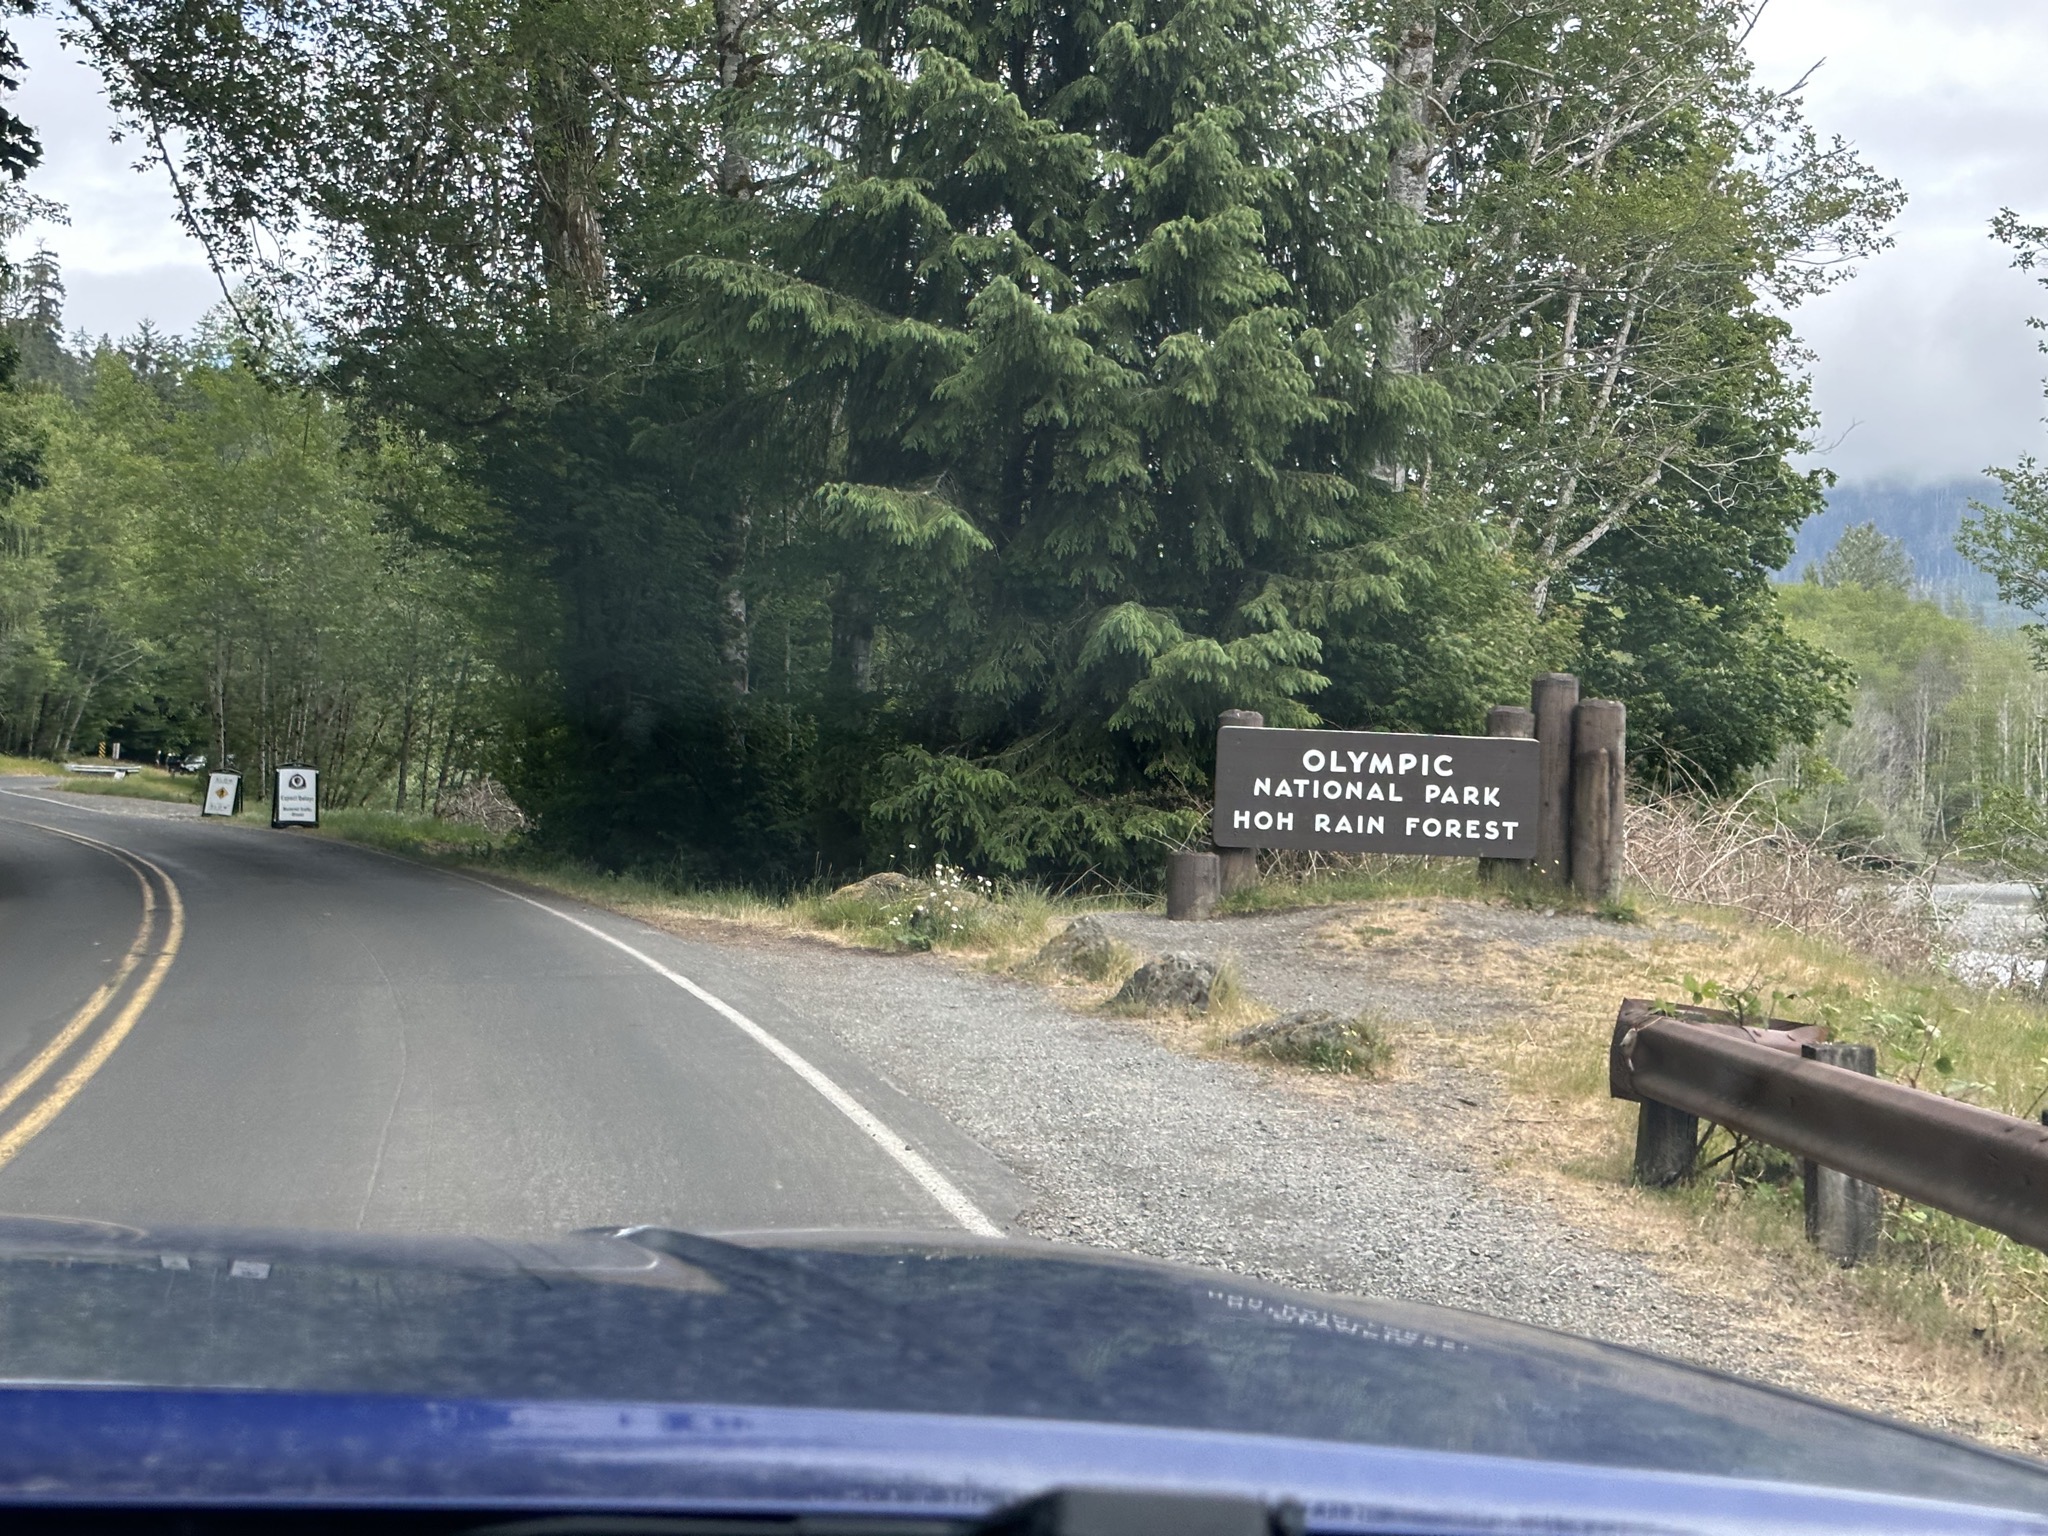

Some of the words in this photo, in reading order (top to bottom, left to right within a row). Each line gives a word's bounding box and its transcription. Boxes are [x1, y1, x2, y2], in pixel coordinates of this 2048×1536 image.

[1302, 748, 1455, 777] OLYMPIC
[1253, 777, 1404, 802] NATIONAL
[1425, 784, 1501, 808] PARK
[1233, 809, 1294, 831] HOH
[1314, 813, 1385, 835] RAIN
[1405, 817, 1519, 841] FOREST
